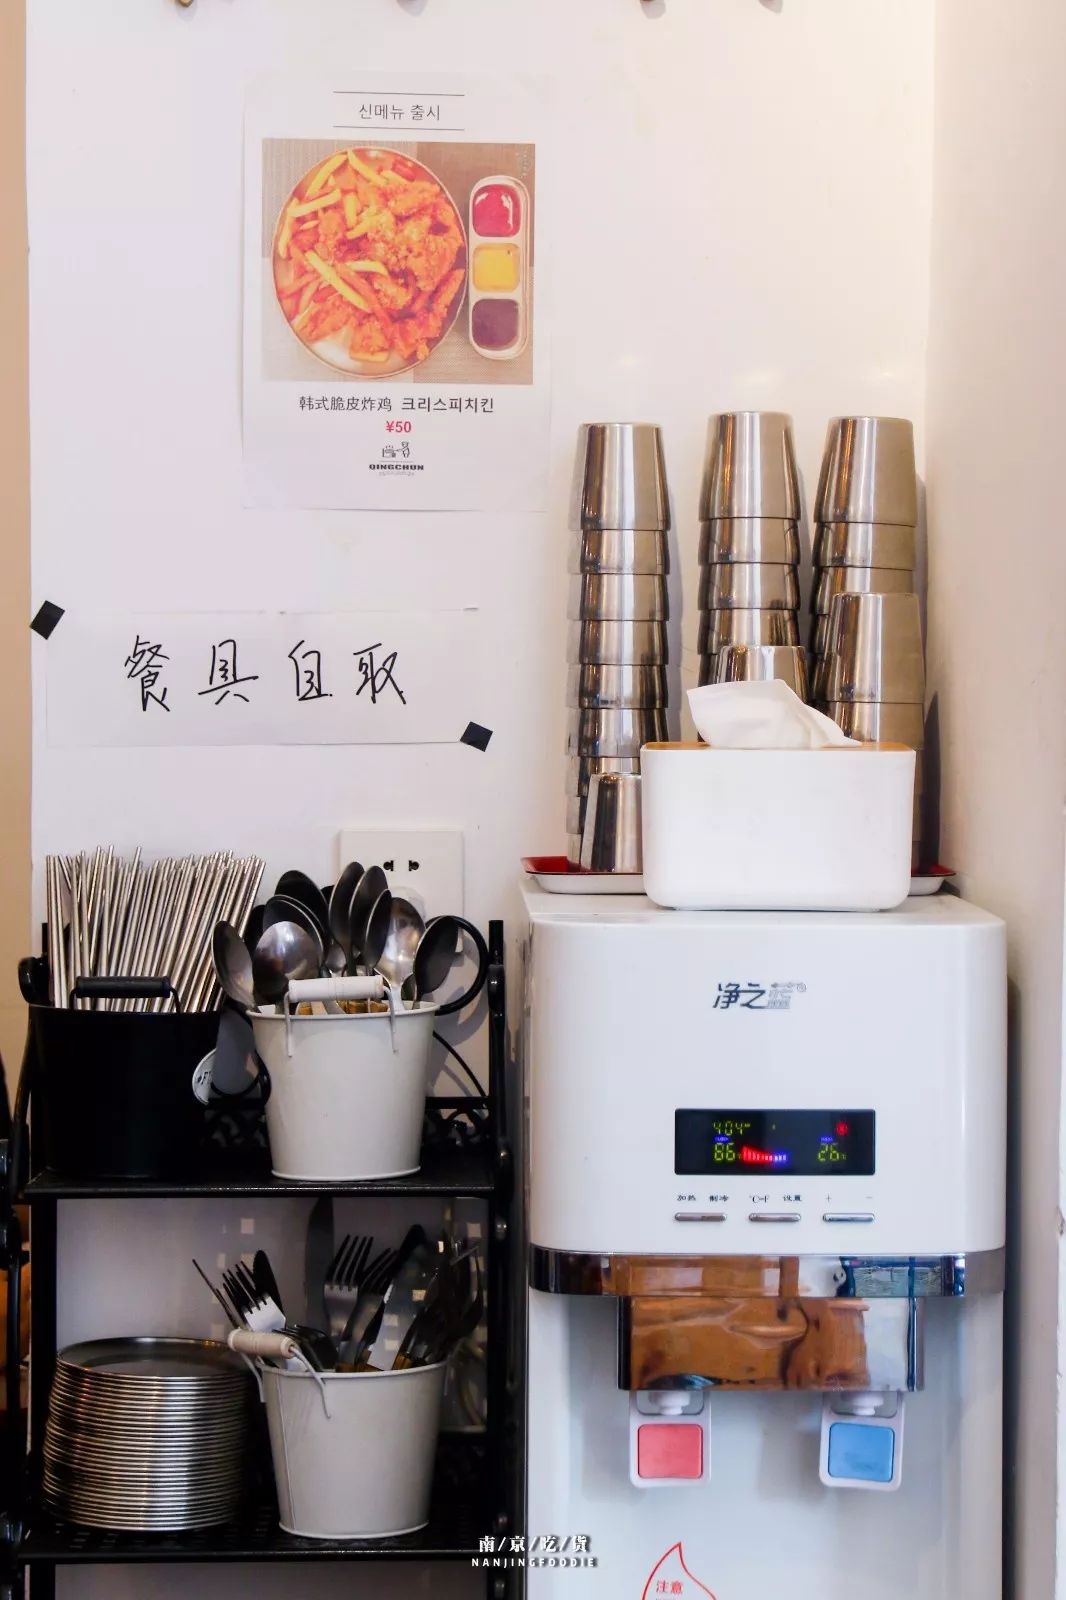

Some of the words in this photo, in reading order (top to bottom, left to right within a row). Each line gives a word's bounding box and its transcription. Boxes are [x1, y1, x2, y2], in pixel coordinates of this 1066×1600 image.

[358, 103, 405, 121] 신메뉴
[410, 104, 441, 121] 출시
[299, 395, 393, 412] 韩式脆皮炸鸡
[401, 396, 495, 414] 크리스피치킨
[385, 420, 412, 433] ¥50
[368, 463, 424, 471] QINGCHUN
[656, 1580, 683, 1594] 注意
